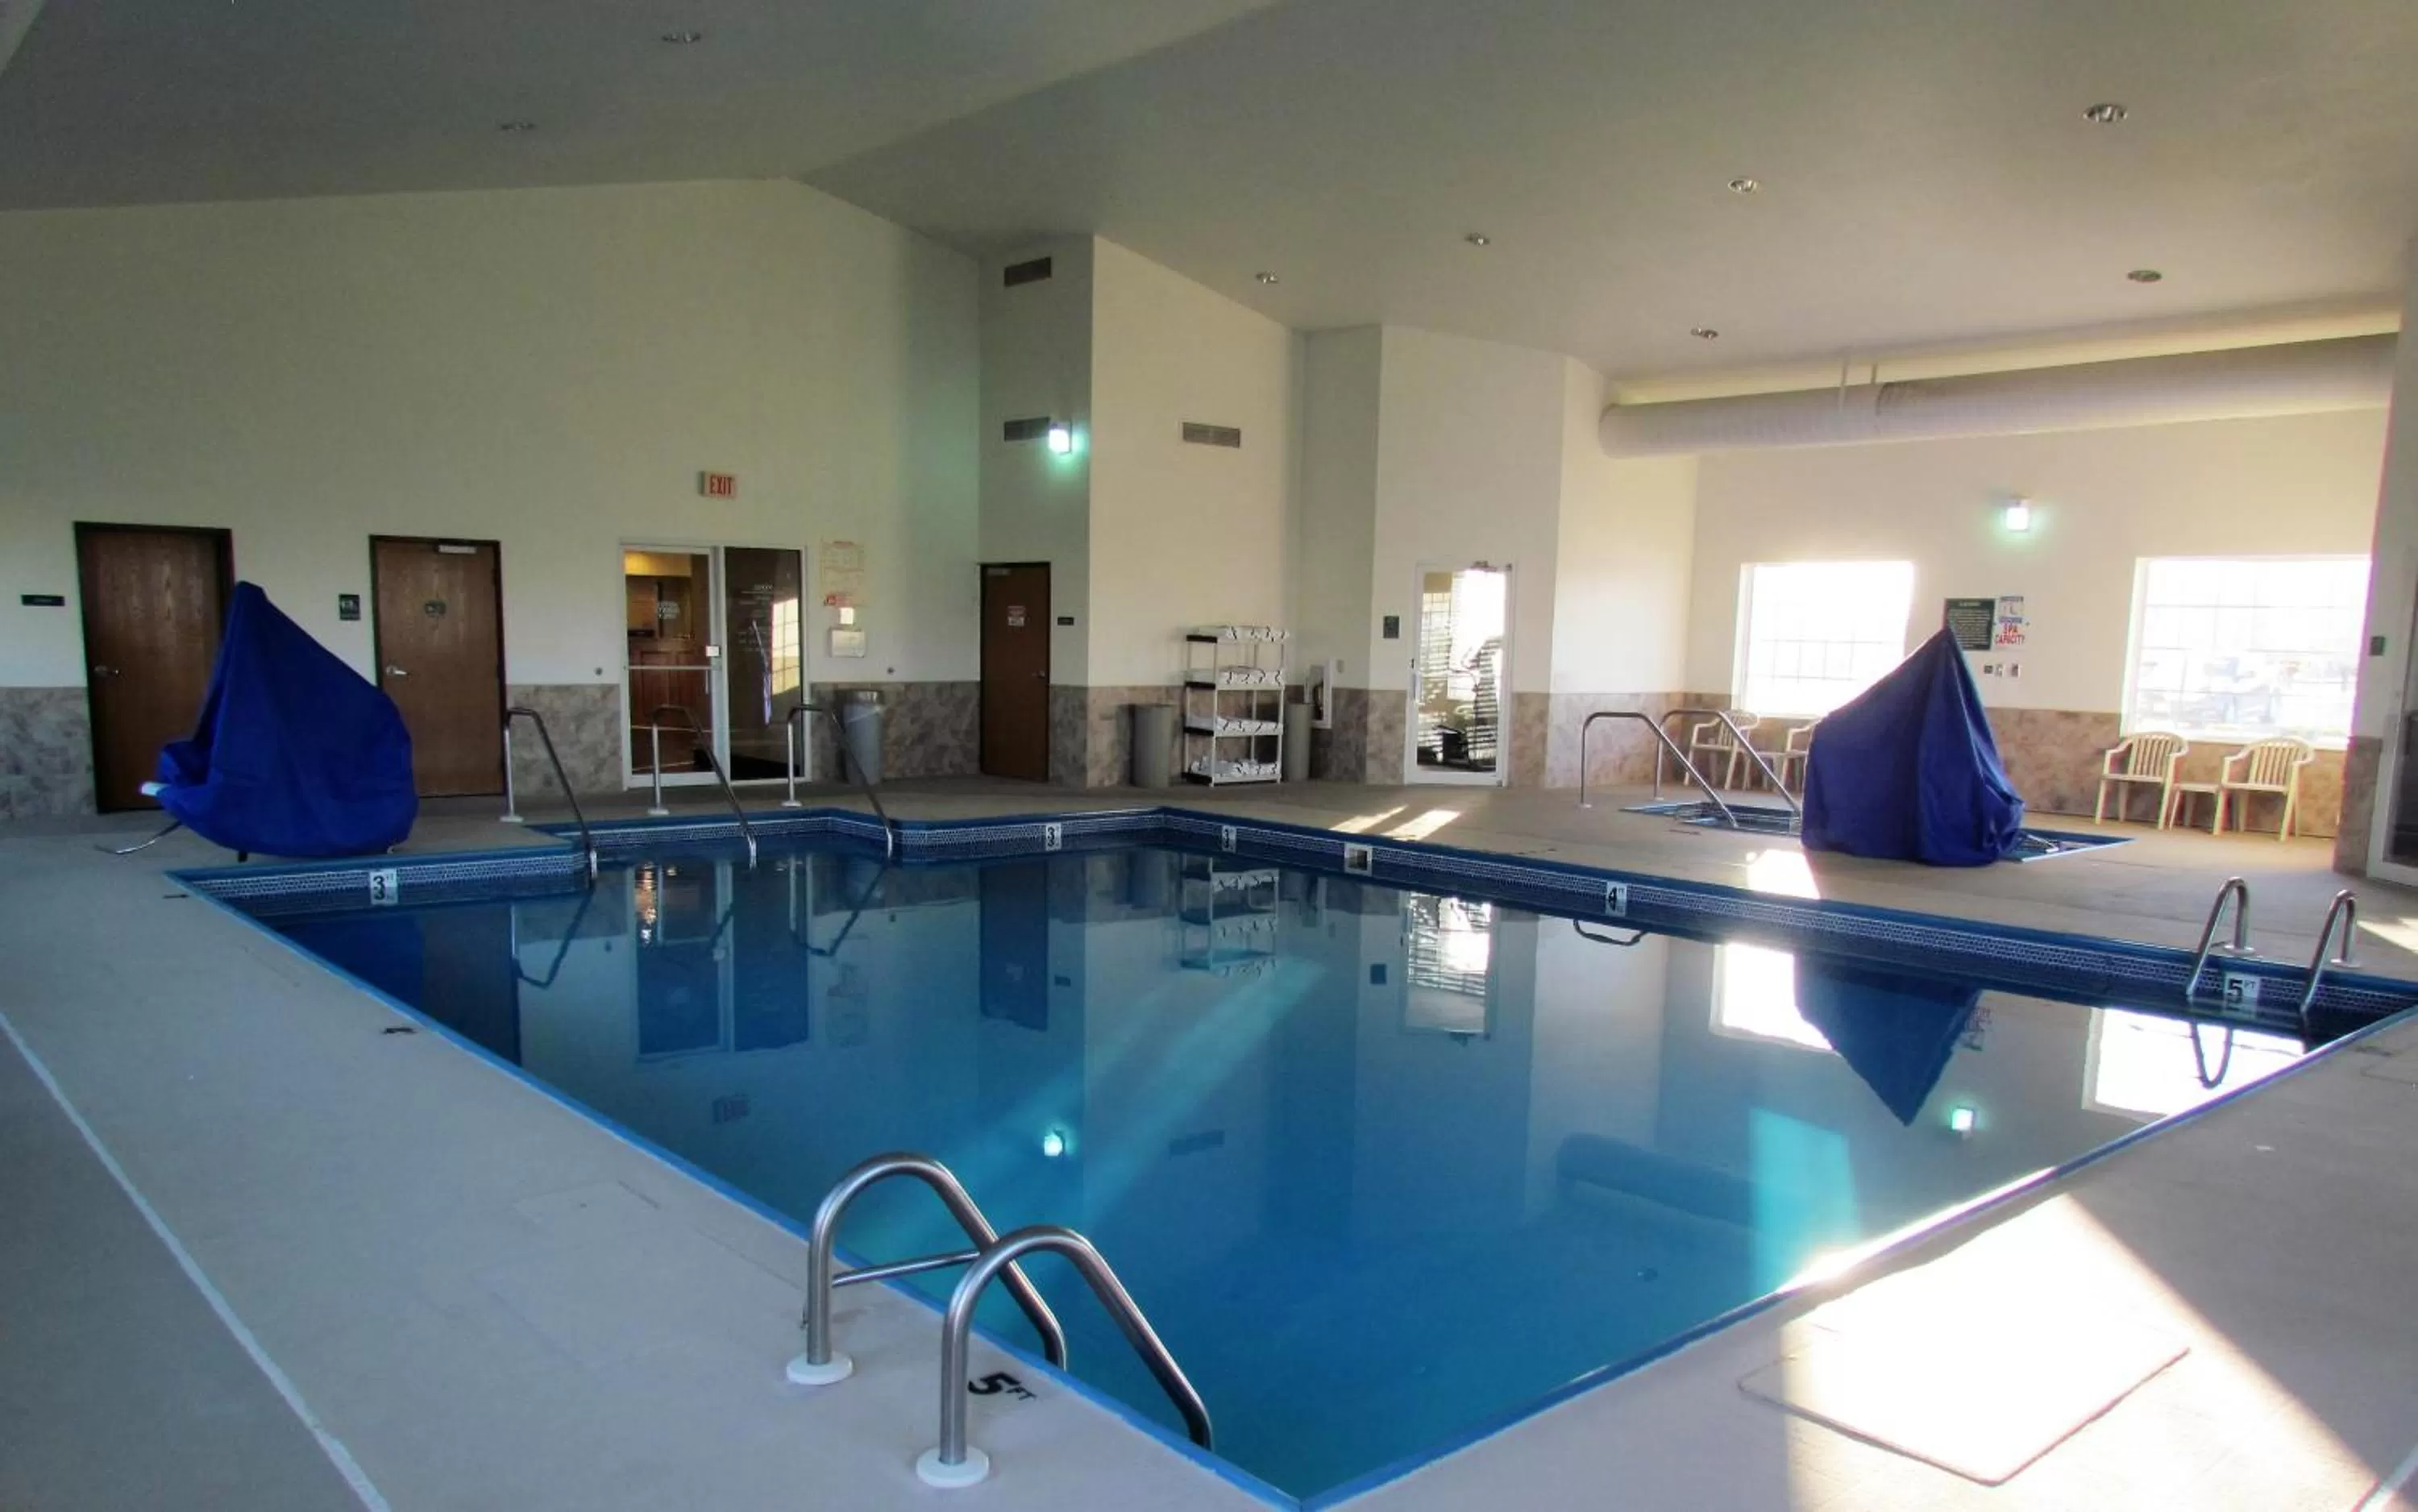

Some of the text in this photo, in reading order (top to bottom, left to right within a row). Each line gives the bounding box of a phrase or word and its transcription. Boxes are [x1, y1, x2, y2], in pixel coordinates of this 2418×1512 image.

[709, 474, 733, 495] EXIT
[2002, 624, 2018, 634] SPA
[1047, 826, 1055, 846] 3
[372, 874, 385, 899] 3
[1608, 886, 1618, 908] 4
[2228, 978, 2243, 1003] 5
[967, 1372, 1021, 1395] 5
